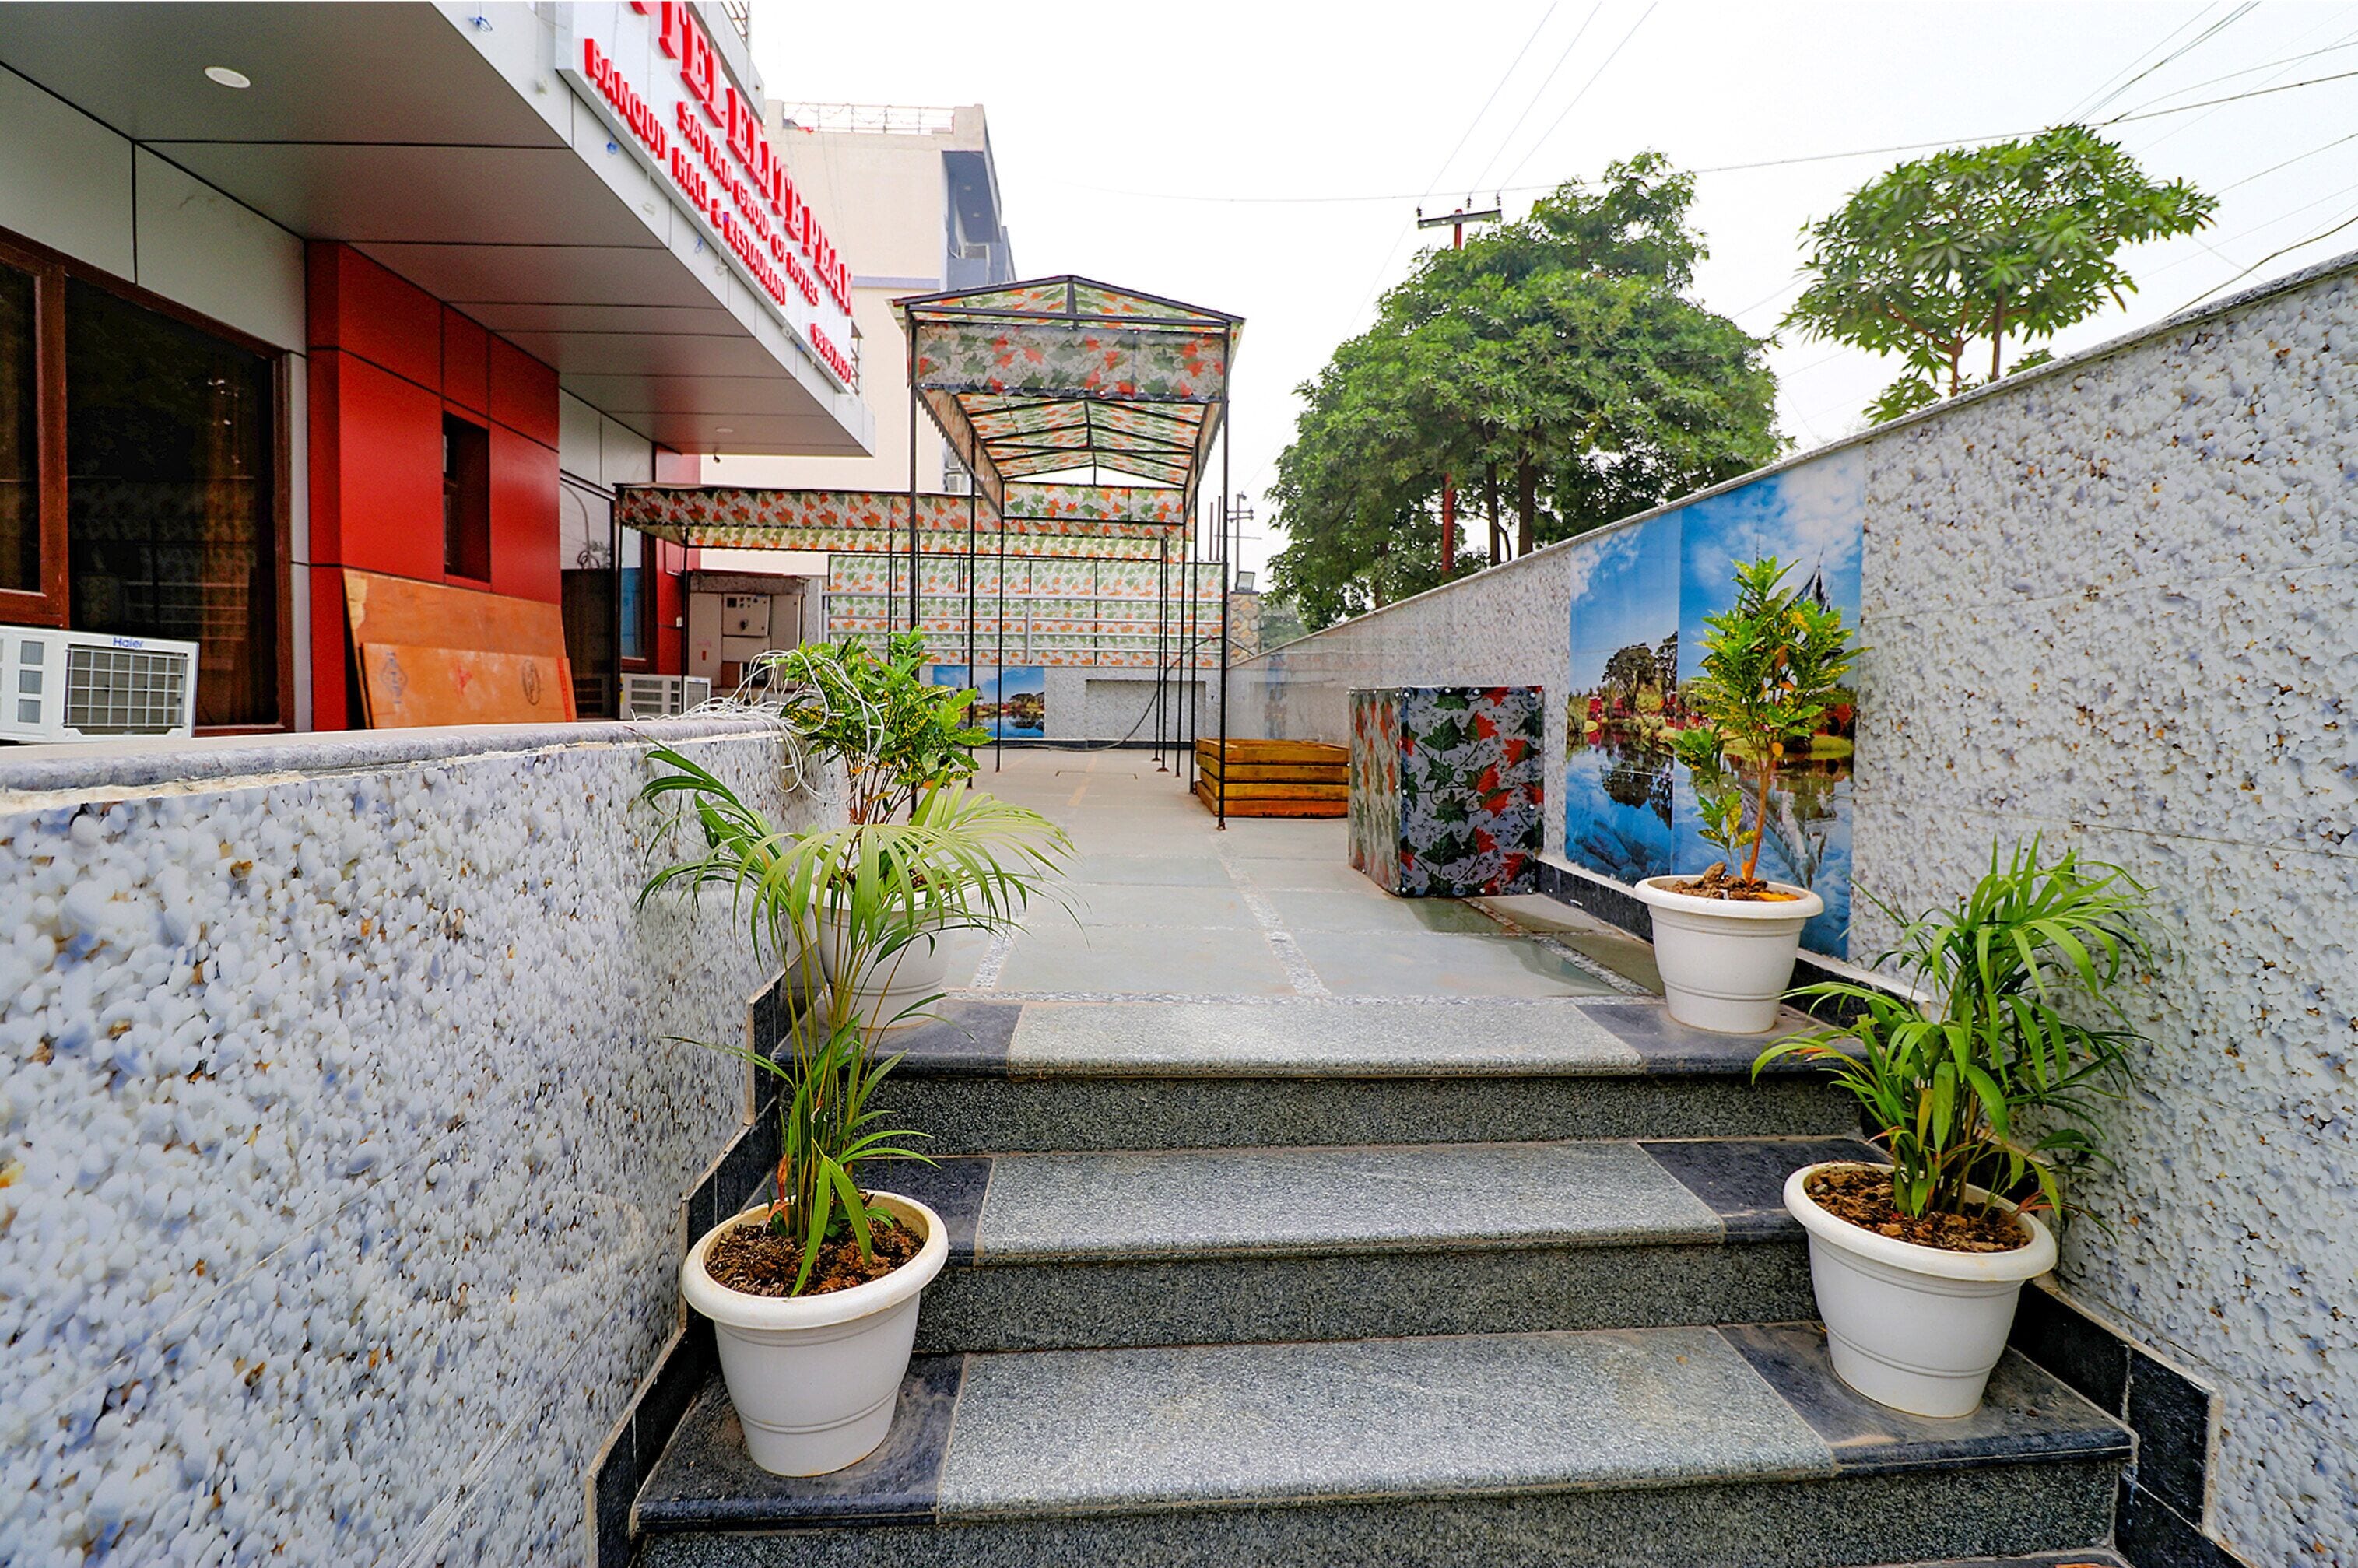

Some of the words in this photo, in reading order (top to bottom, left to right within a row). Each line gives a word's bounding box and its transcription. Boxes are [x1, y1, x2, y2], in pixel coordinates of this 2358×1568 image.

[630, 2, 726, 127] TEL
[726, 88, 801, 241] ELITE
[676, 101, 734, 191] SATYAM
[672, 147, 711, 211] HALL
[711, 198, 724, 229] &
[723, 212, 786, 305] RESTAURANT
[113, 637, 144, 648] Haier
